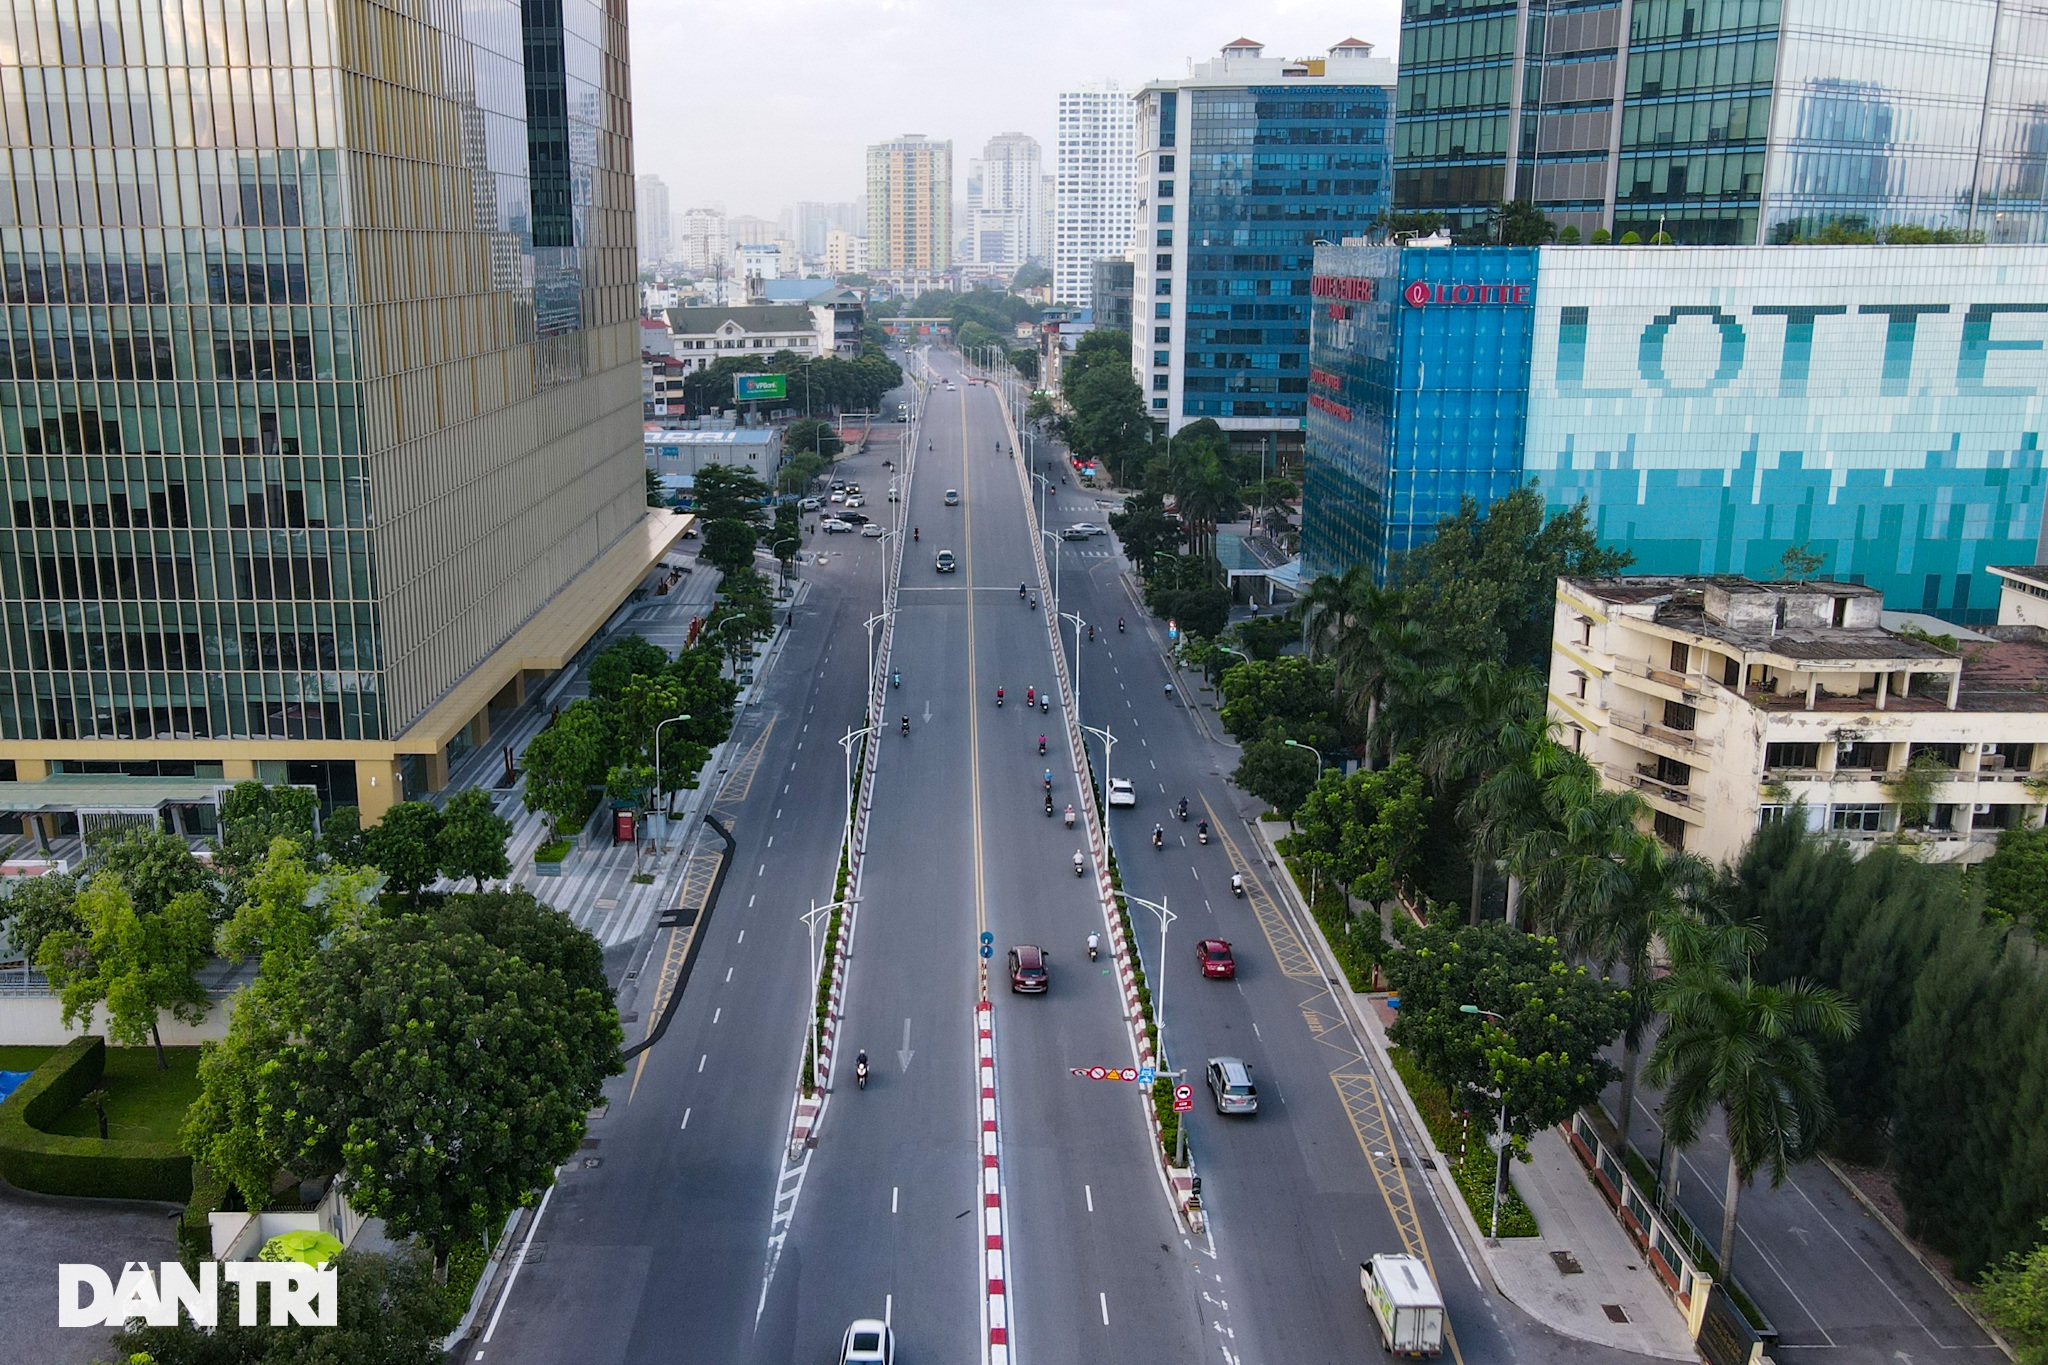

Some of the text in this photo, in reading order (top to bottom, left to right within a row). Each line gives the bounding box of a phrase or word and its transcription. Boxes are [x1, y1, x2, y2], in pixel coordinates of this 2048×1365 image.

[1336, 277, 1371, 301] CENTER
[1436, 284, 1530, 305] LOTTE
[1554, 303, 2048, 398] LOTTE
